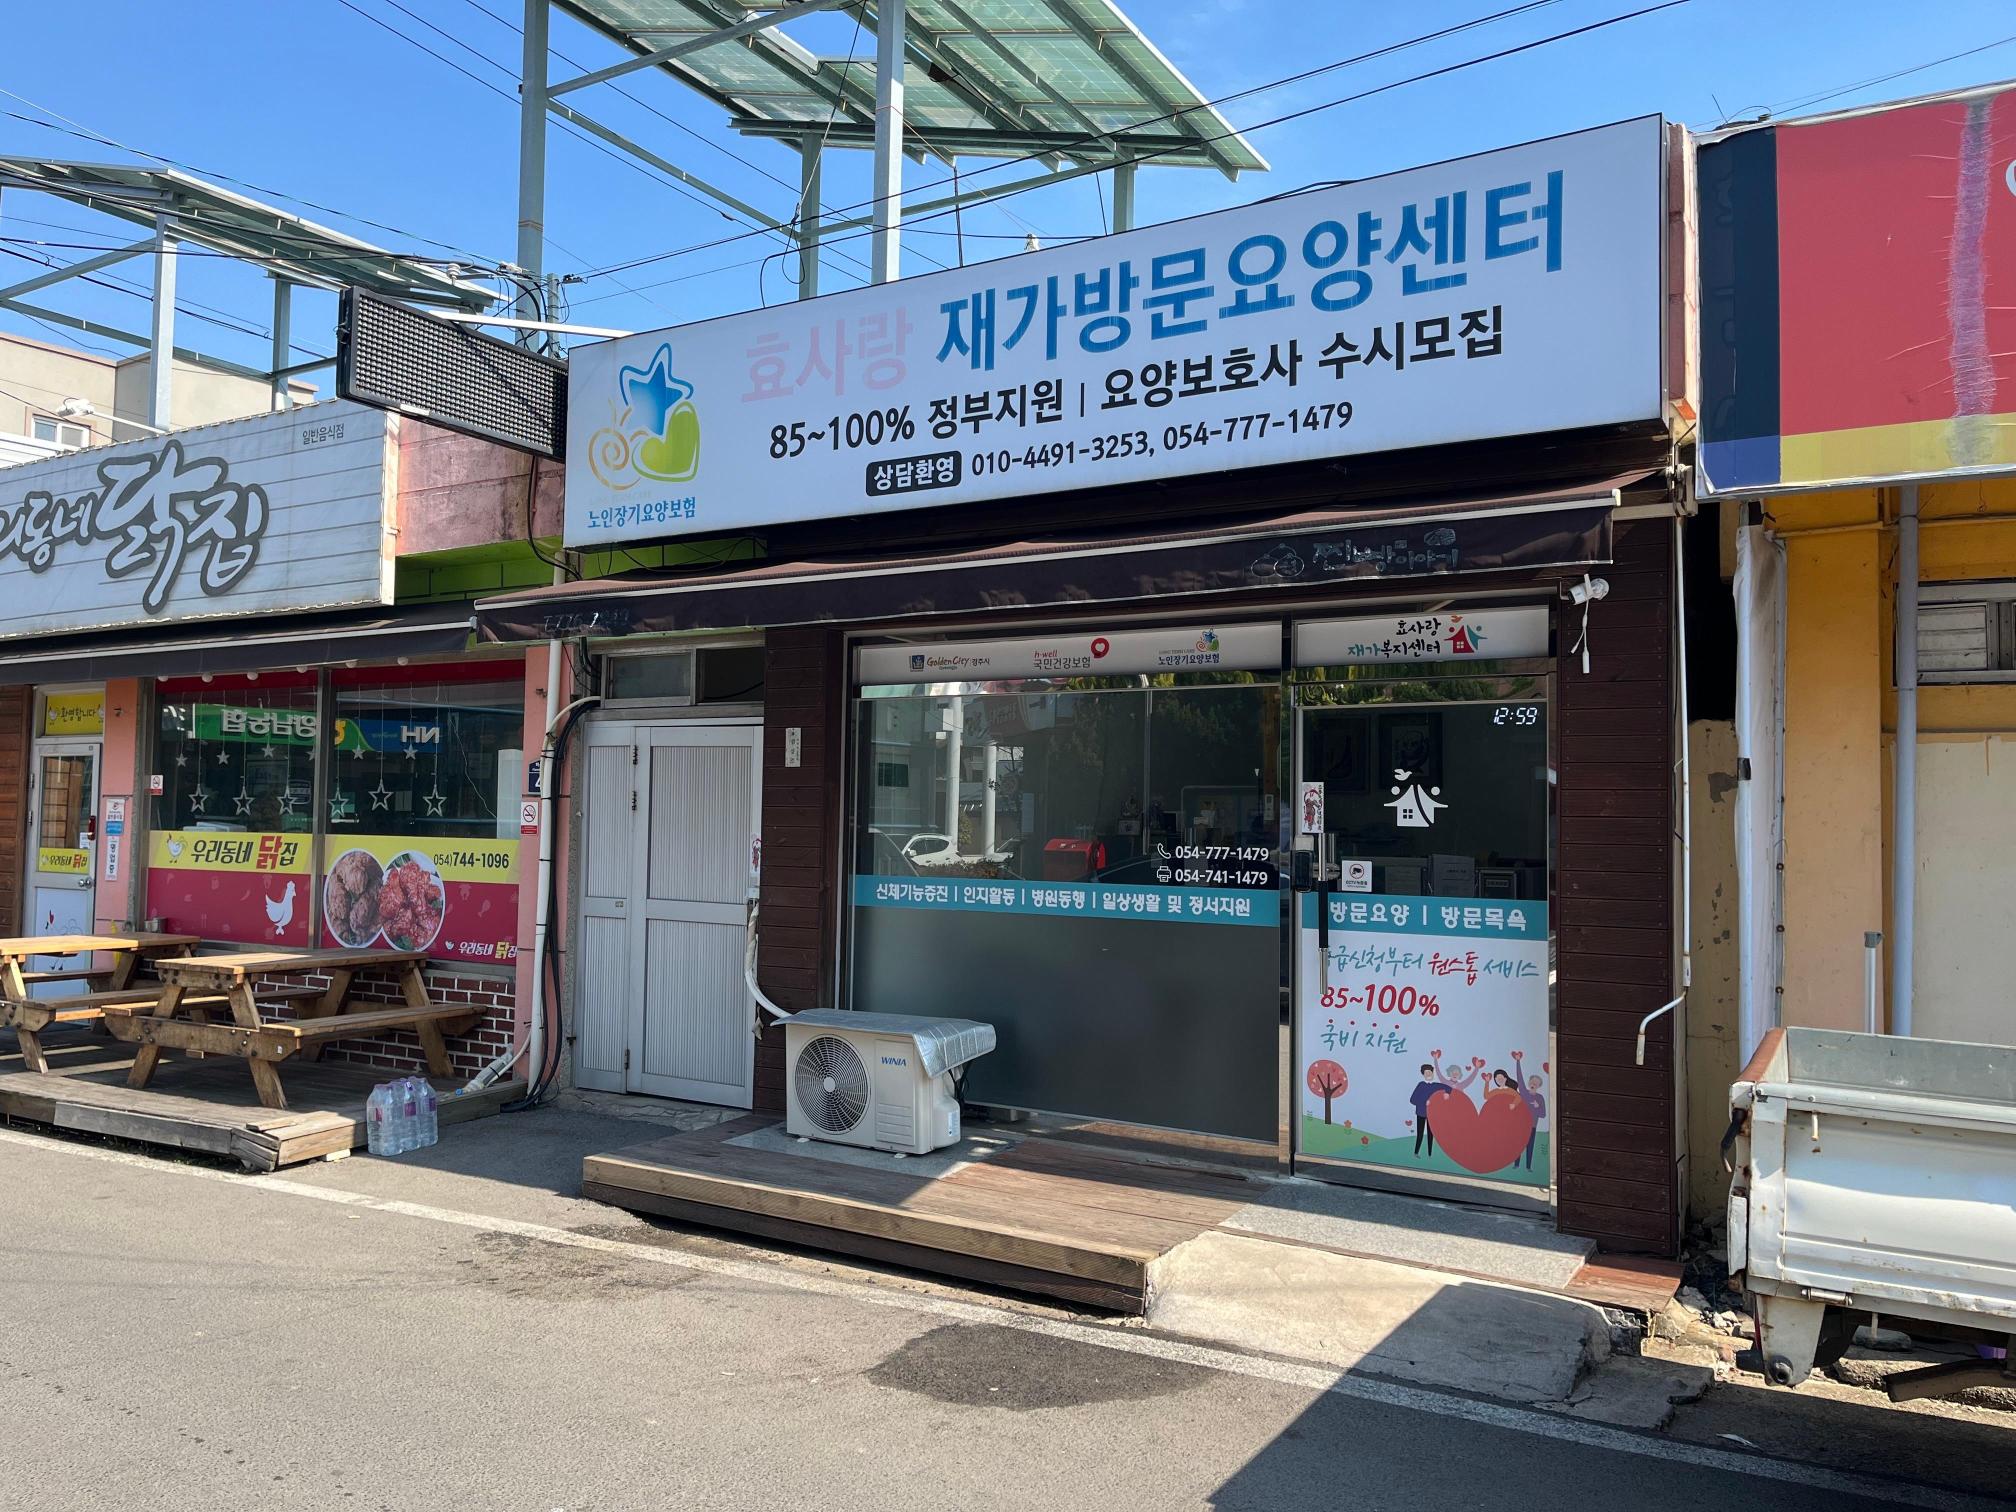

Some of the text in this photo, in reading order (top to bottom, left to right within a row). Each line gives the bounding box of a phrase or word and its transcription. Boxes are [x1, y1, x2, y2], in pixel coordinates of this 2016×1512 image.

[740, 169, 1564, 405] 효사랑 재가방문요양센터
[769, 304, 1504, 461] 85~100% 정부지원 요양보호사 수시모집
[302, 423, 346, 446] 일반음식점
[873, 457, 956, 492] 상담환영
[1162, 401, 1354, 452] 054-777-1479
[587, 496, 697, 529] 노인장기요양보험
[1395, 617, 1442, 637] 효사랑
[1158, 653, 1220, 666] 노인장기요양보험
[1346, 639, 1441, 659] 재가복지센터
[1033, 657, 1091, 670] 국민건강보험
[1493, 707, 1538, 725] 12:59
[191, 835, 298, 871] 우리동네 닭집
[433, 850, 510, 870] 054)744-1096
[1174, 846, 1270, 862] 054-777-1479
[1174, 868, 1269, 886] 054-741-1479
[876, 883, 1252, 918] 신체기능증진 인지활동 병원동행 일상생활 및 정서지원
[1329, 901, 1527, 931] 방문요양 방문목욕
[458, 941, 518, 960] 우리동네 닭집
[1427, 951, 1480, 987] 원스톱
[1483, 958, 1540, 978] 서비스
[1320, 983, 1441, 1017] 85~100%
